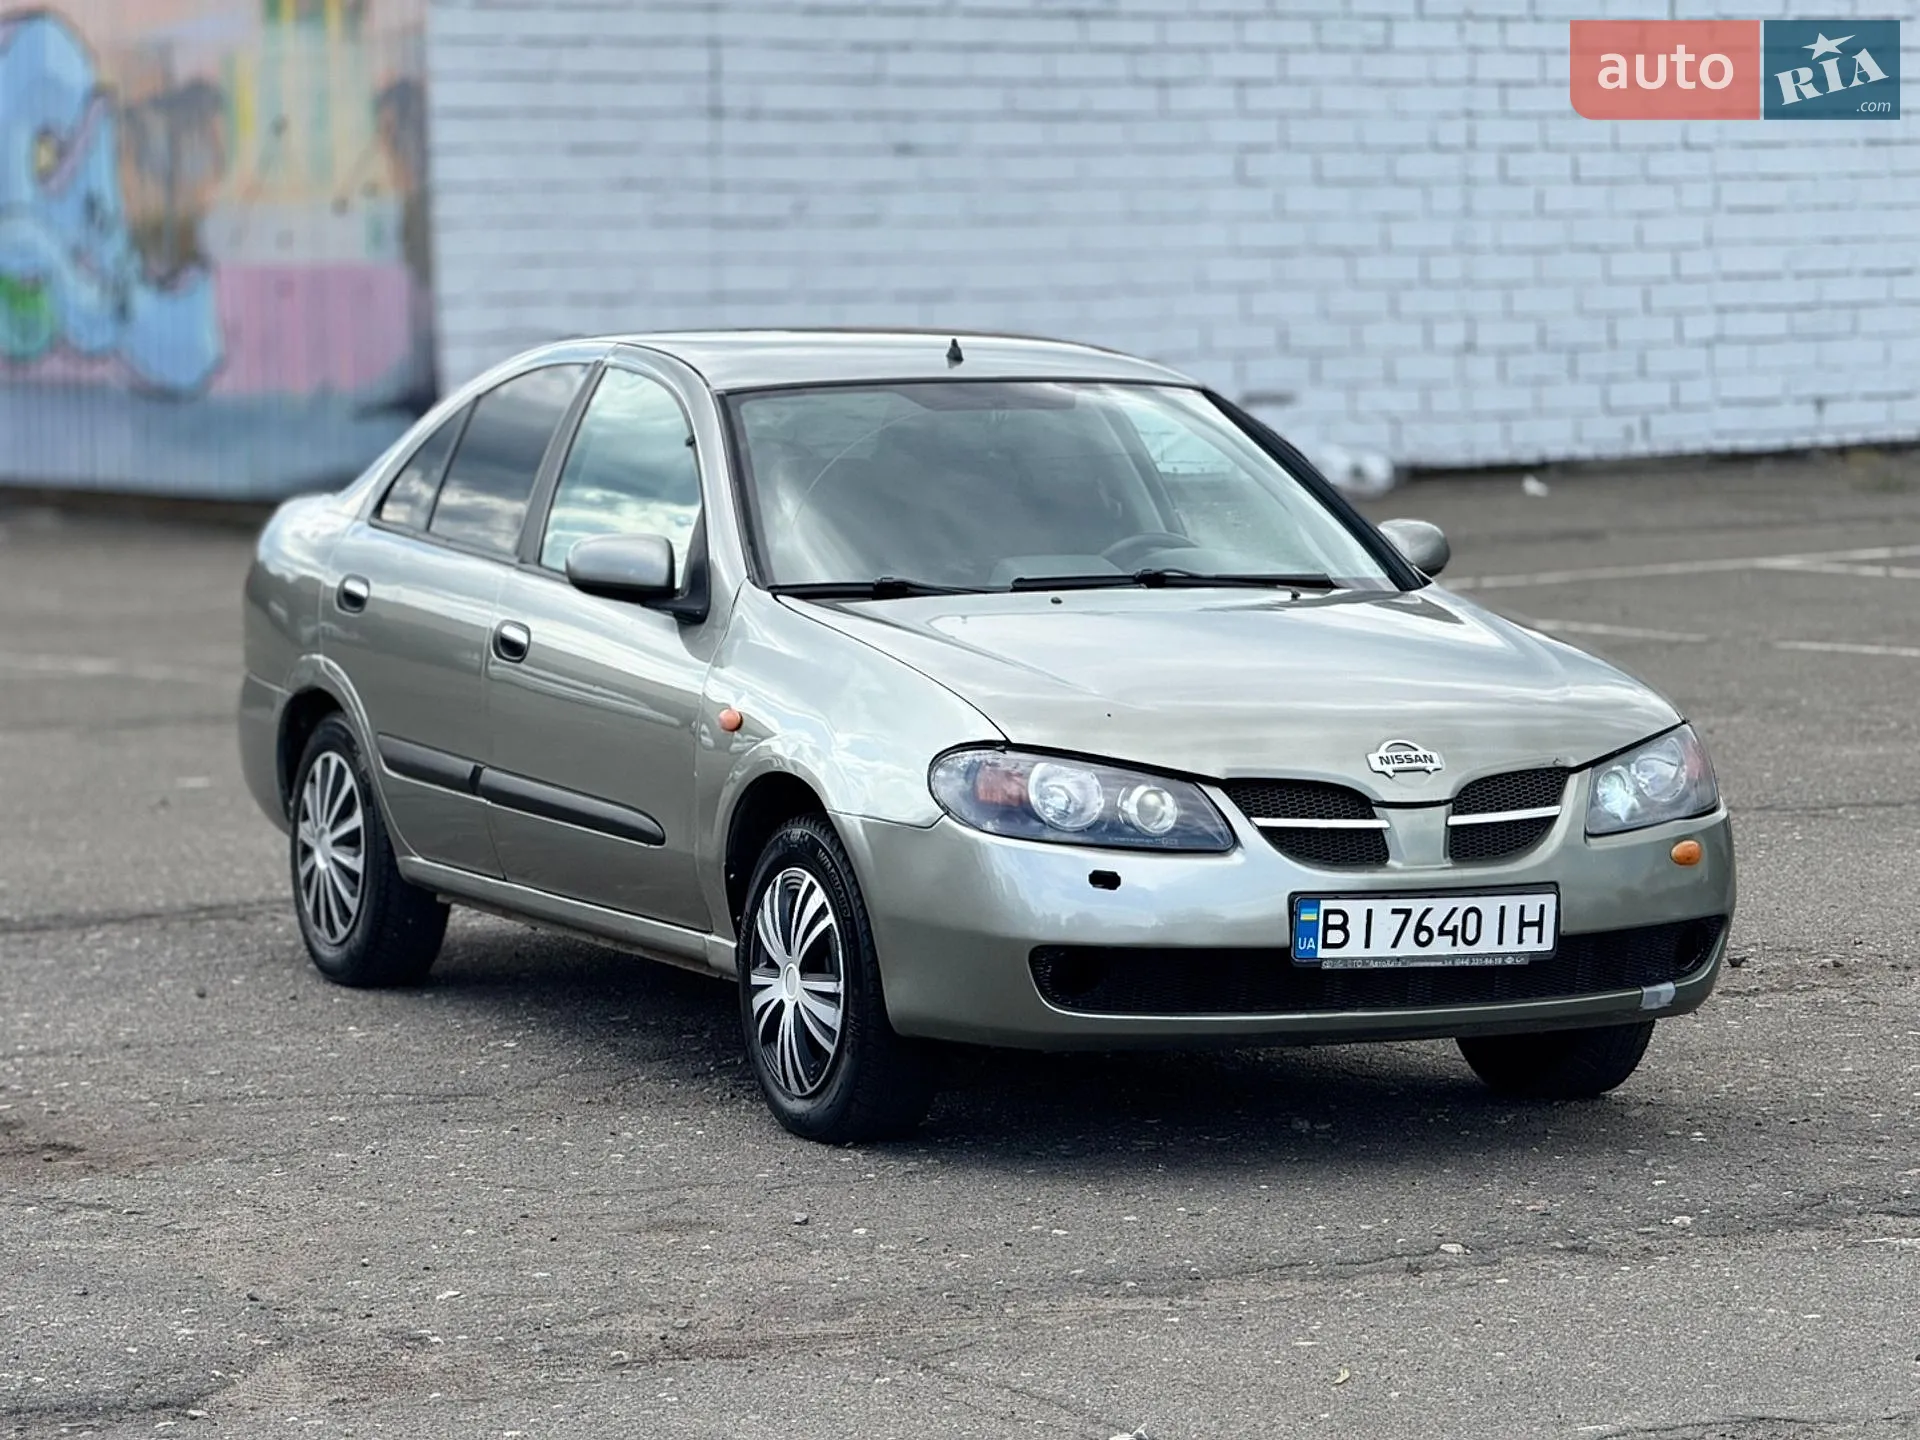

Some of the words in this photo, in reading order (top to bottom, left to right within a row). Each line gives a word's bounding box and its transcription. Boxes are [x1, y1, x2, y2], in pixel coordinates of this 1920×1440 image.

[1378, 754, 1435, 766] NISSAN
[1391, 906, 1483, 949] 7640
[1298, 937, 1317, 951] UA
